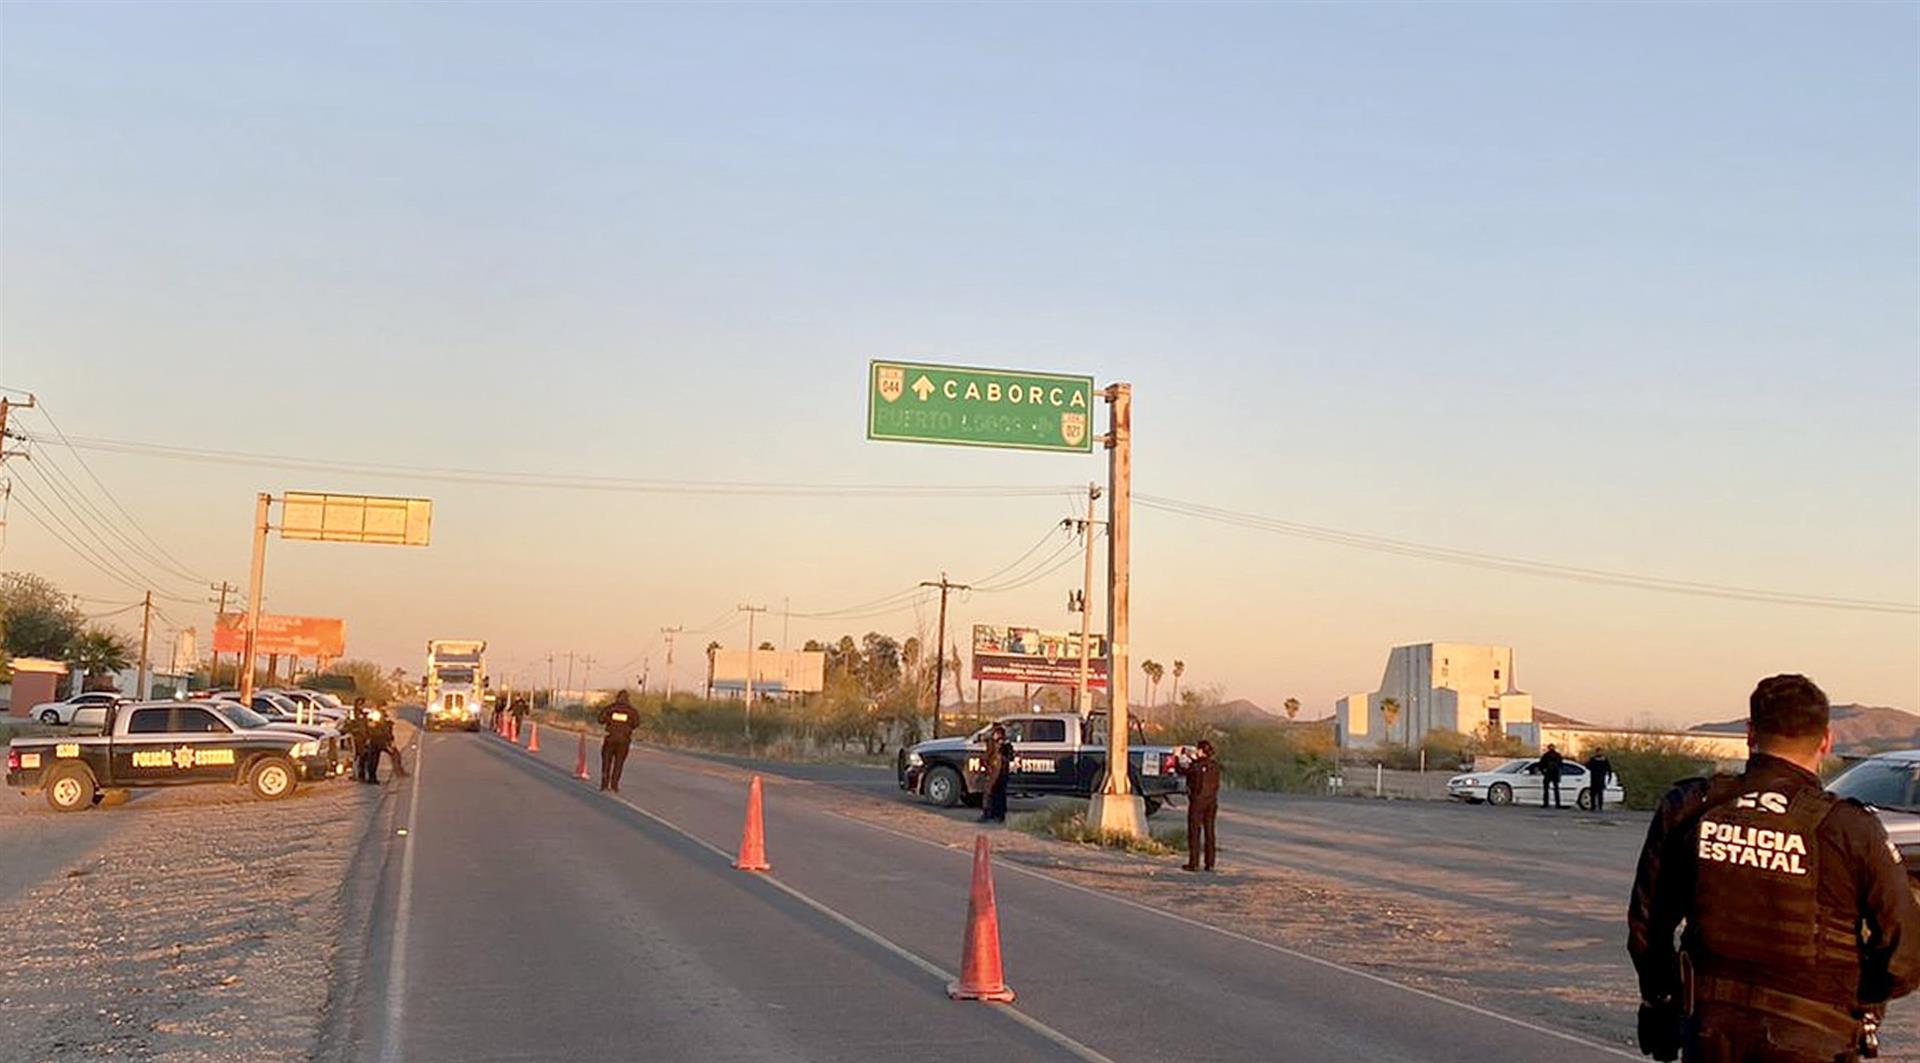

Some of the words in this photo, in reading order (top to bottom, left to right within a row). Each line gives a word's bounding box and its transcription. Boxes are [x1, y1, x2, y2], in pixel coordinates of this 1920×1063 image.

[882, 381, 900, 393] 044
[943, 379, 1086, 408] CABORCA
[195, 749, 235, 765] ESTATAL
[1021, 758, 1056, 773] ESTATAL
[1700, 821, 1807, 855] POLICIA
[1698, 840, 1807, 875] ESTATAL
